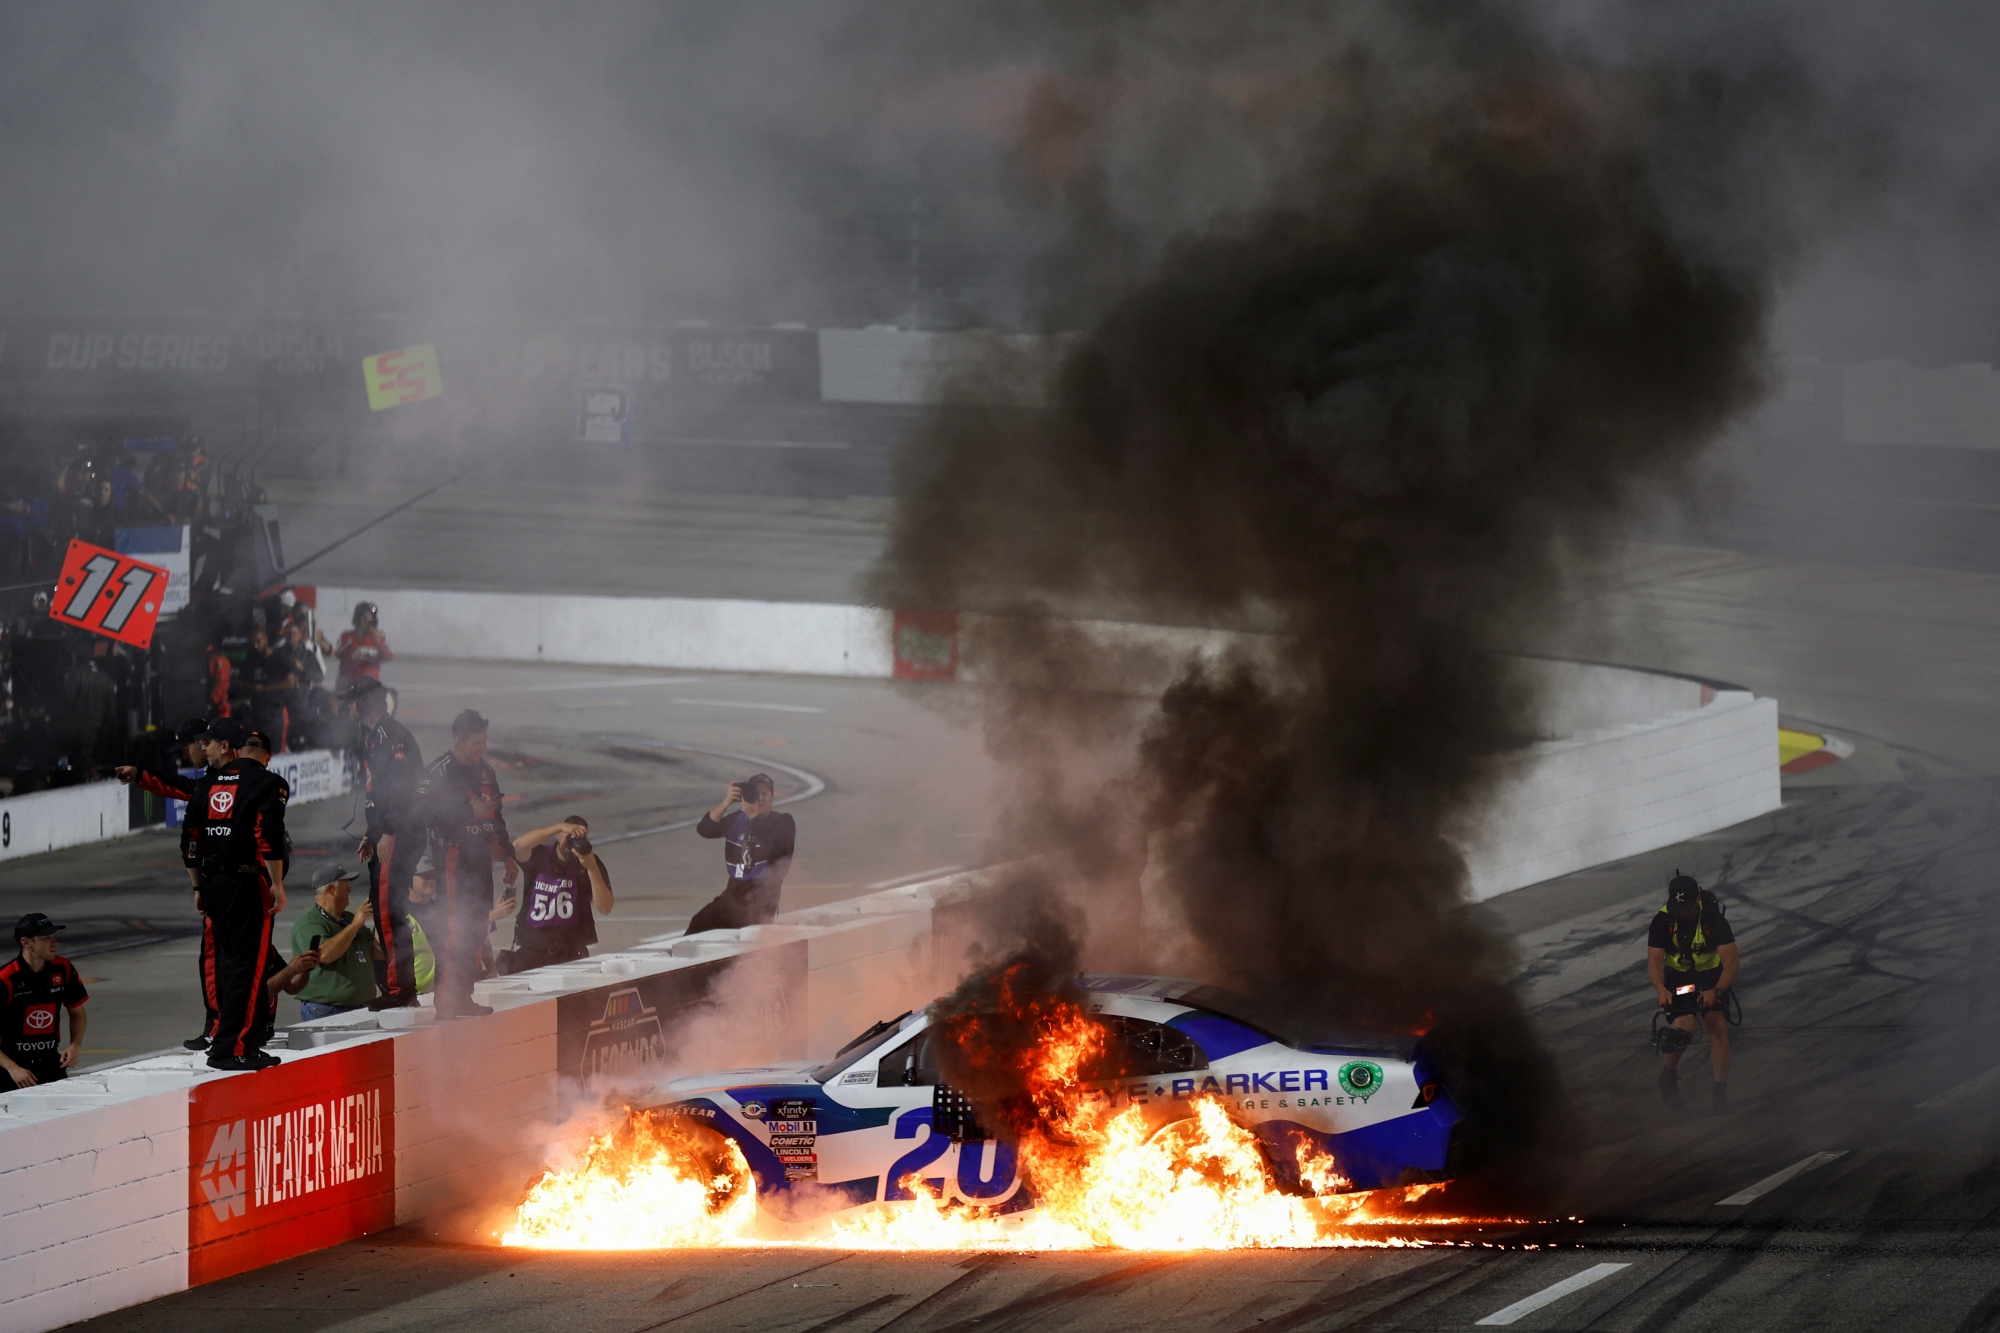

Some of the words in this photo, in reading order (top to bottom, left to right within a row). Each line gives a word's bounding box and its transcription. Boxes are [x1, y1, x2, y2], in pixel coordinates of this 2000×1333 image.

[62, 553, 157, 633] 11
[2, 811, 11, 848] 9
[611, 1017, 636, 1032] NASCAR
[1172, 1069, 1329, 1101] BARKER
[1278, 1098, 1289, 1109] &
[1297, 1094, 1370, 1108] SAFETY
[777, 1105, 809, 1117] xfinity
[769, 1121, 801, 1132] Mobil
[254, 1103, 326, 1208] WEAVER
[330, 1087, 383, 1187] MEDIA
[771, 1136, 815, 1146] COMETIC
[775, 1148, 810, 1156] LINCOLN
[884, 1106, 1020, 1202] 20
